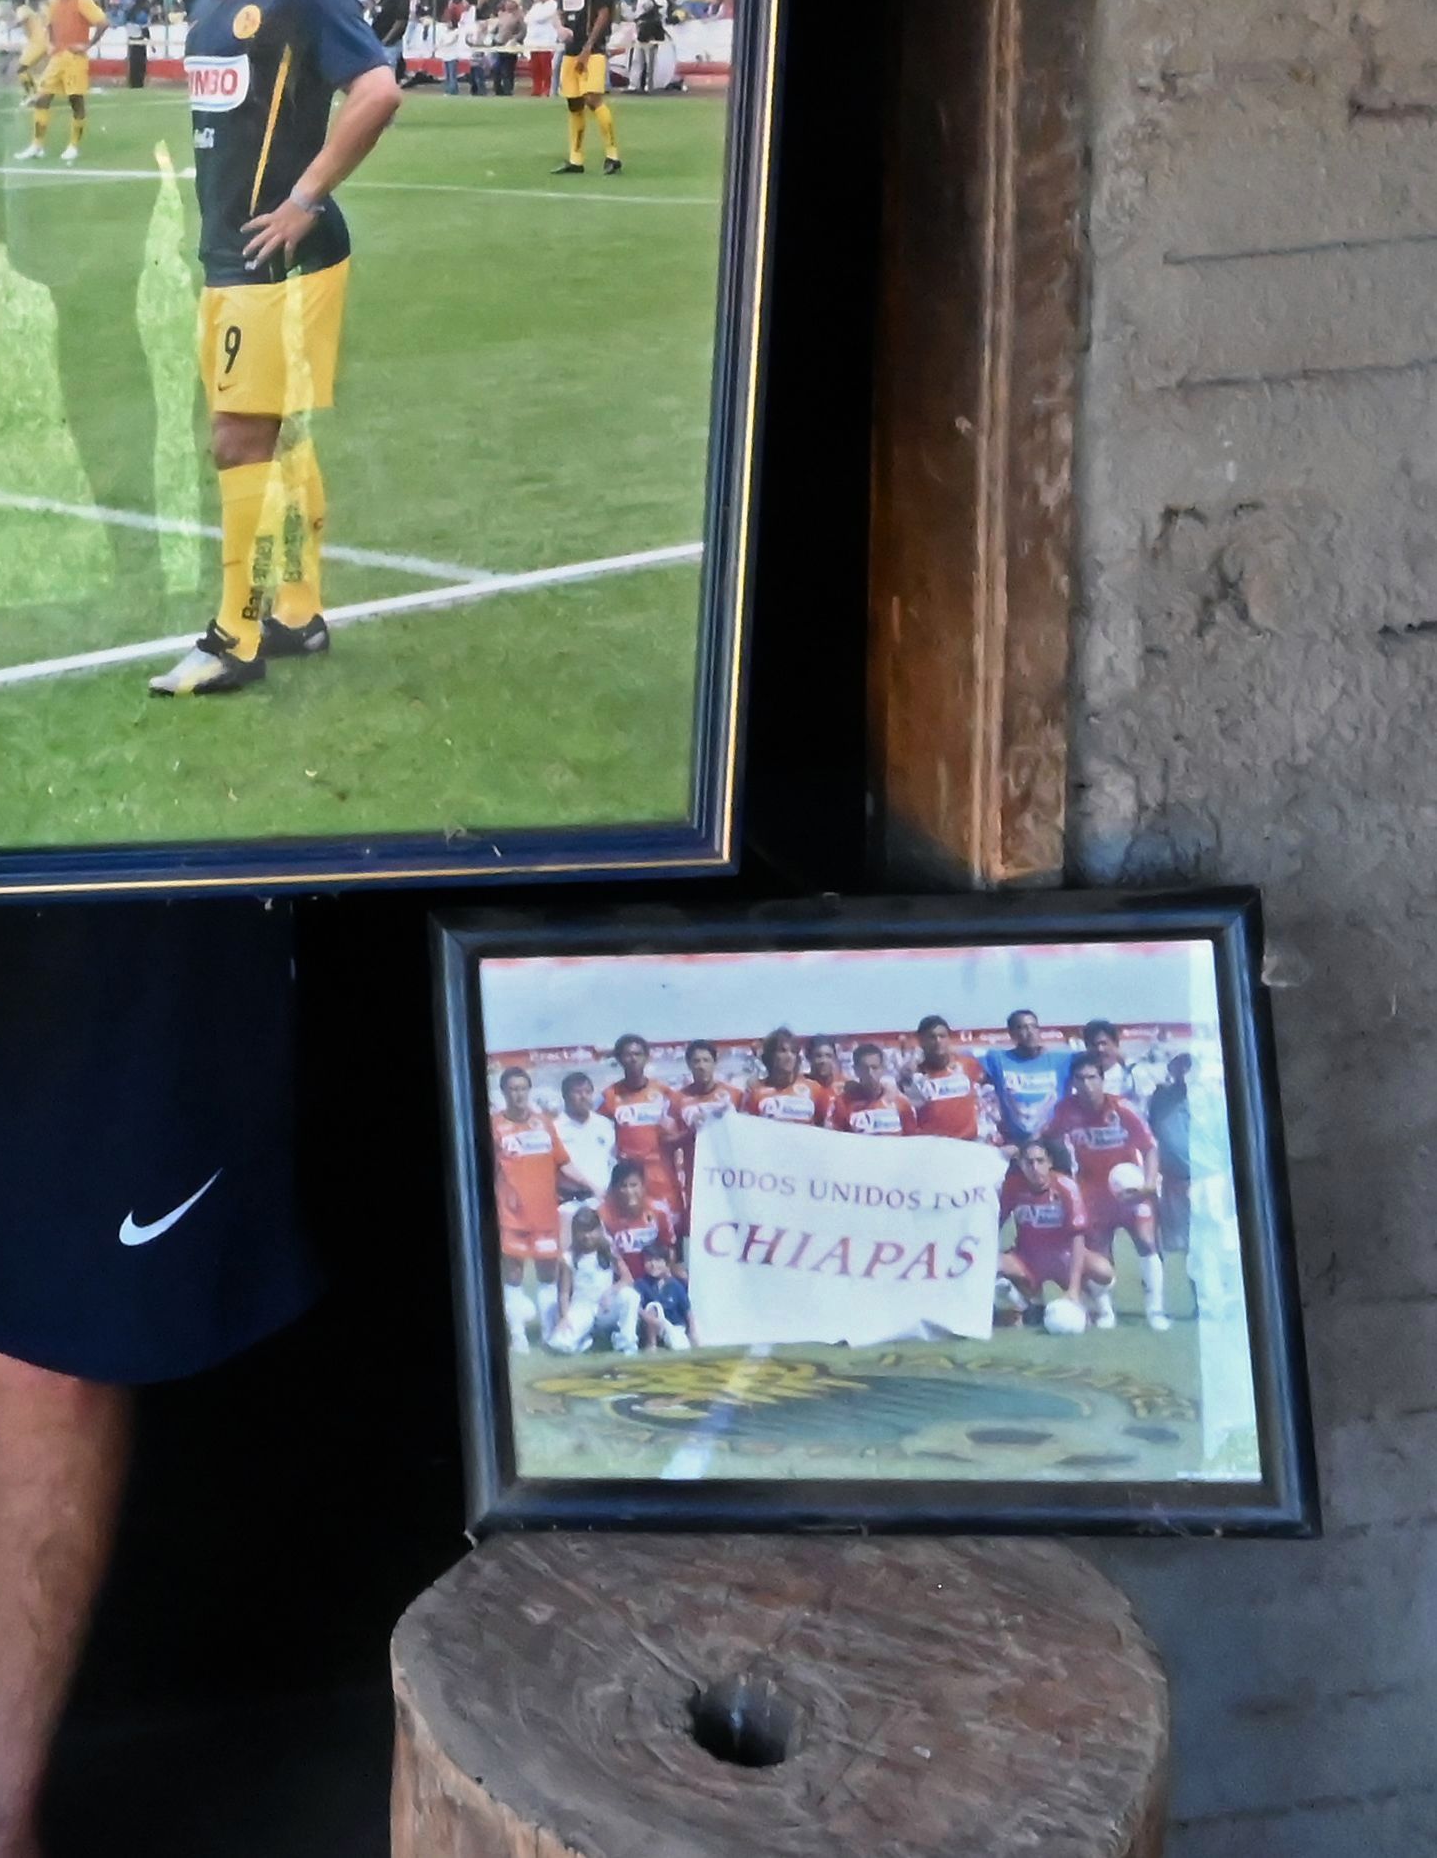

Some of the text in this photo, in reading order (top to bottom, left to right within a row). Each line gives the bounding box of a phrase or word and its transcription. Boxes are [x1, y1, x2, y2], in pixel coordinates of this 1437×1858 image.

[224, 325, 242, 374] 9
[703, 1166, 796, 1196] TODOS
[809, 1179, 921, 1211] UNIDOS
[702, 1220, 980, 1281] CHIAPAS
